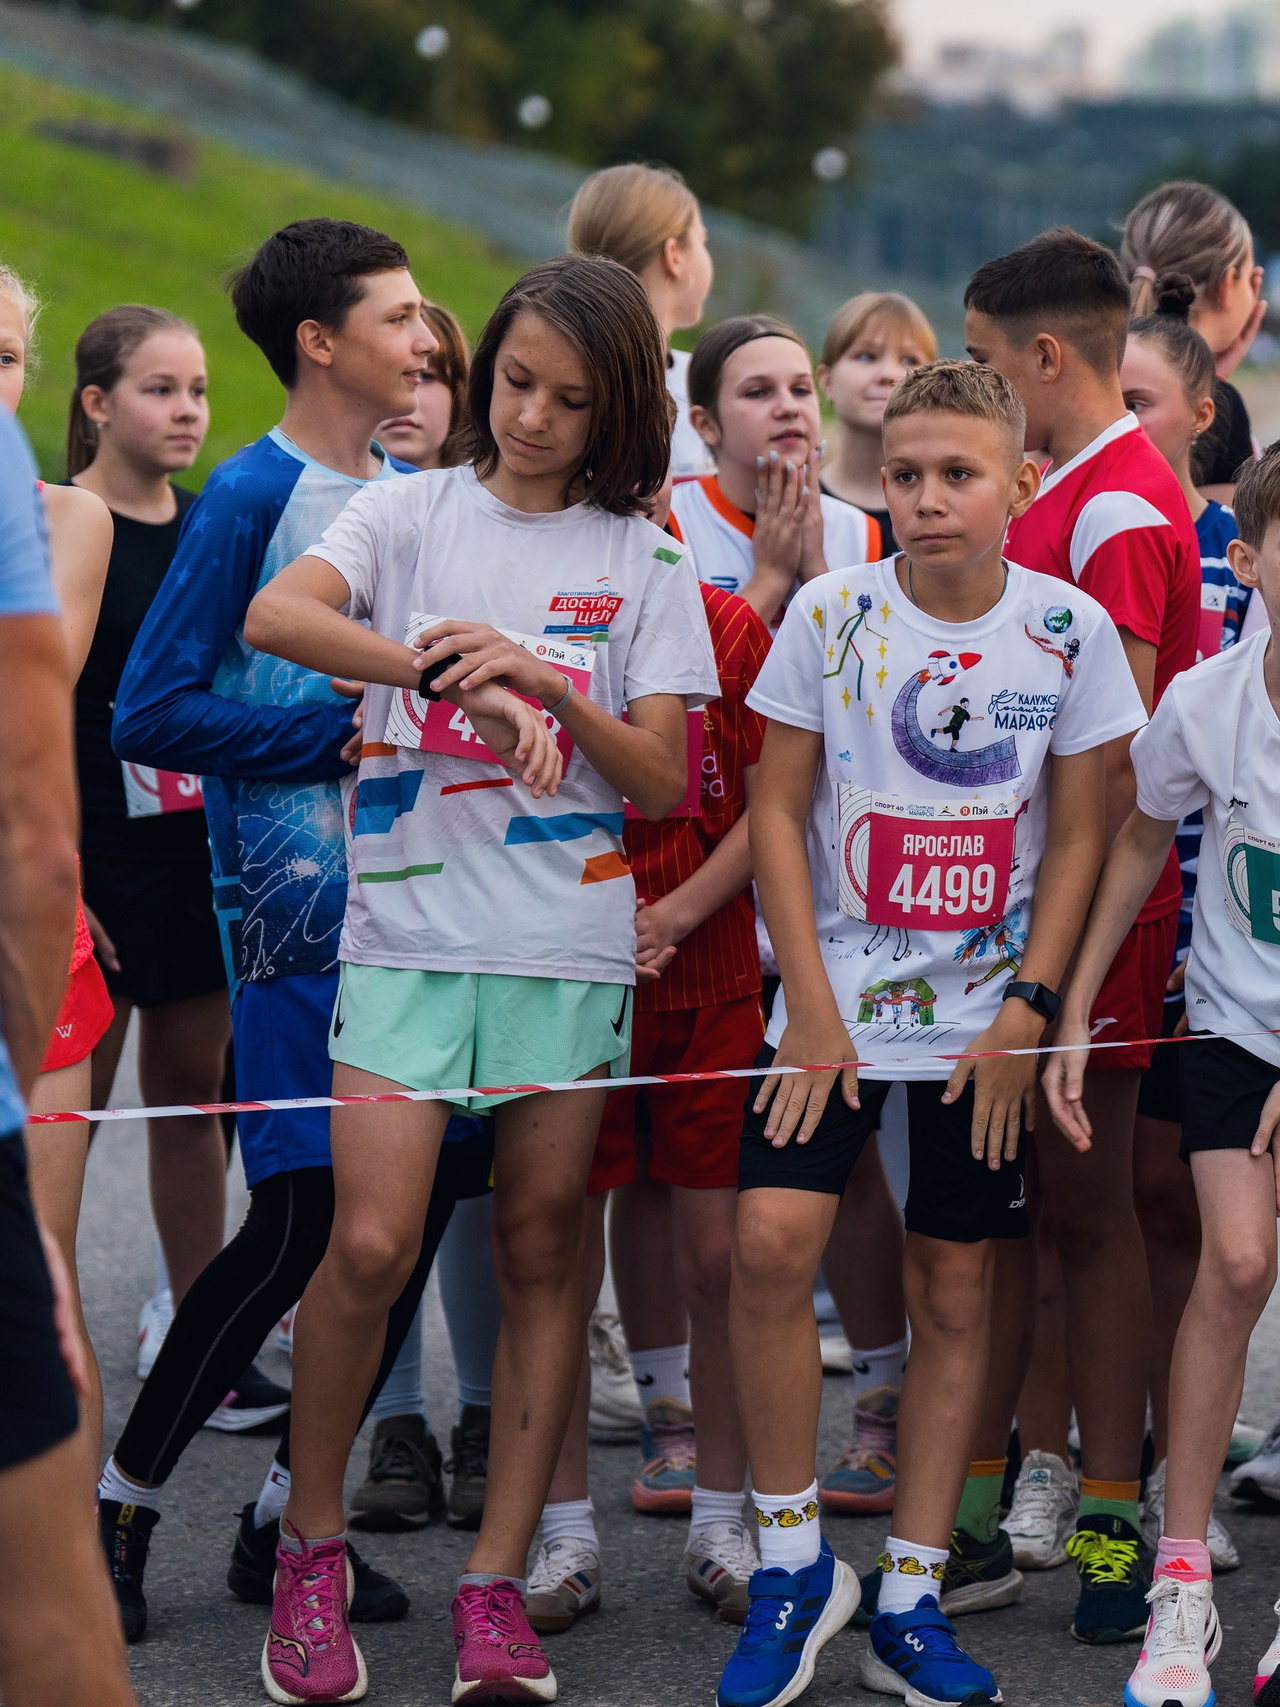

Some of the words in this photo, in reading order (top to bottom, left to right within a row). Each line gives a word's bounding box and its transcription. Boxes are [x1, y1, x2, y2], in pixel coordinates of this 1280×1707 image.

[548, 648, 565, 660] Пэй
[875, 802, 894, 810] СПОРТ
[972, 806, 988, 815] Пэй
[1248, 835, 1266, 844] СПОРТ
[902, 834, 984, 857] ЯРОСЛАВ
[889, 863, 996, 915] 4499
